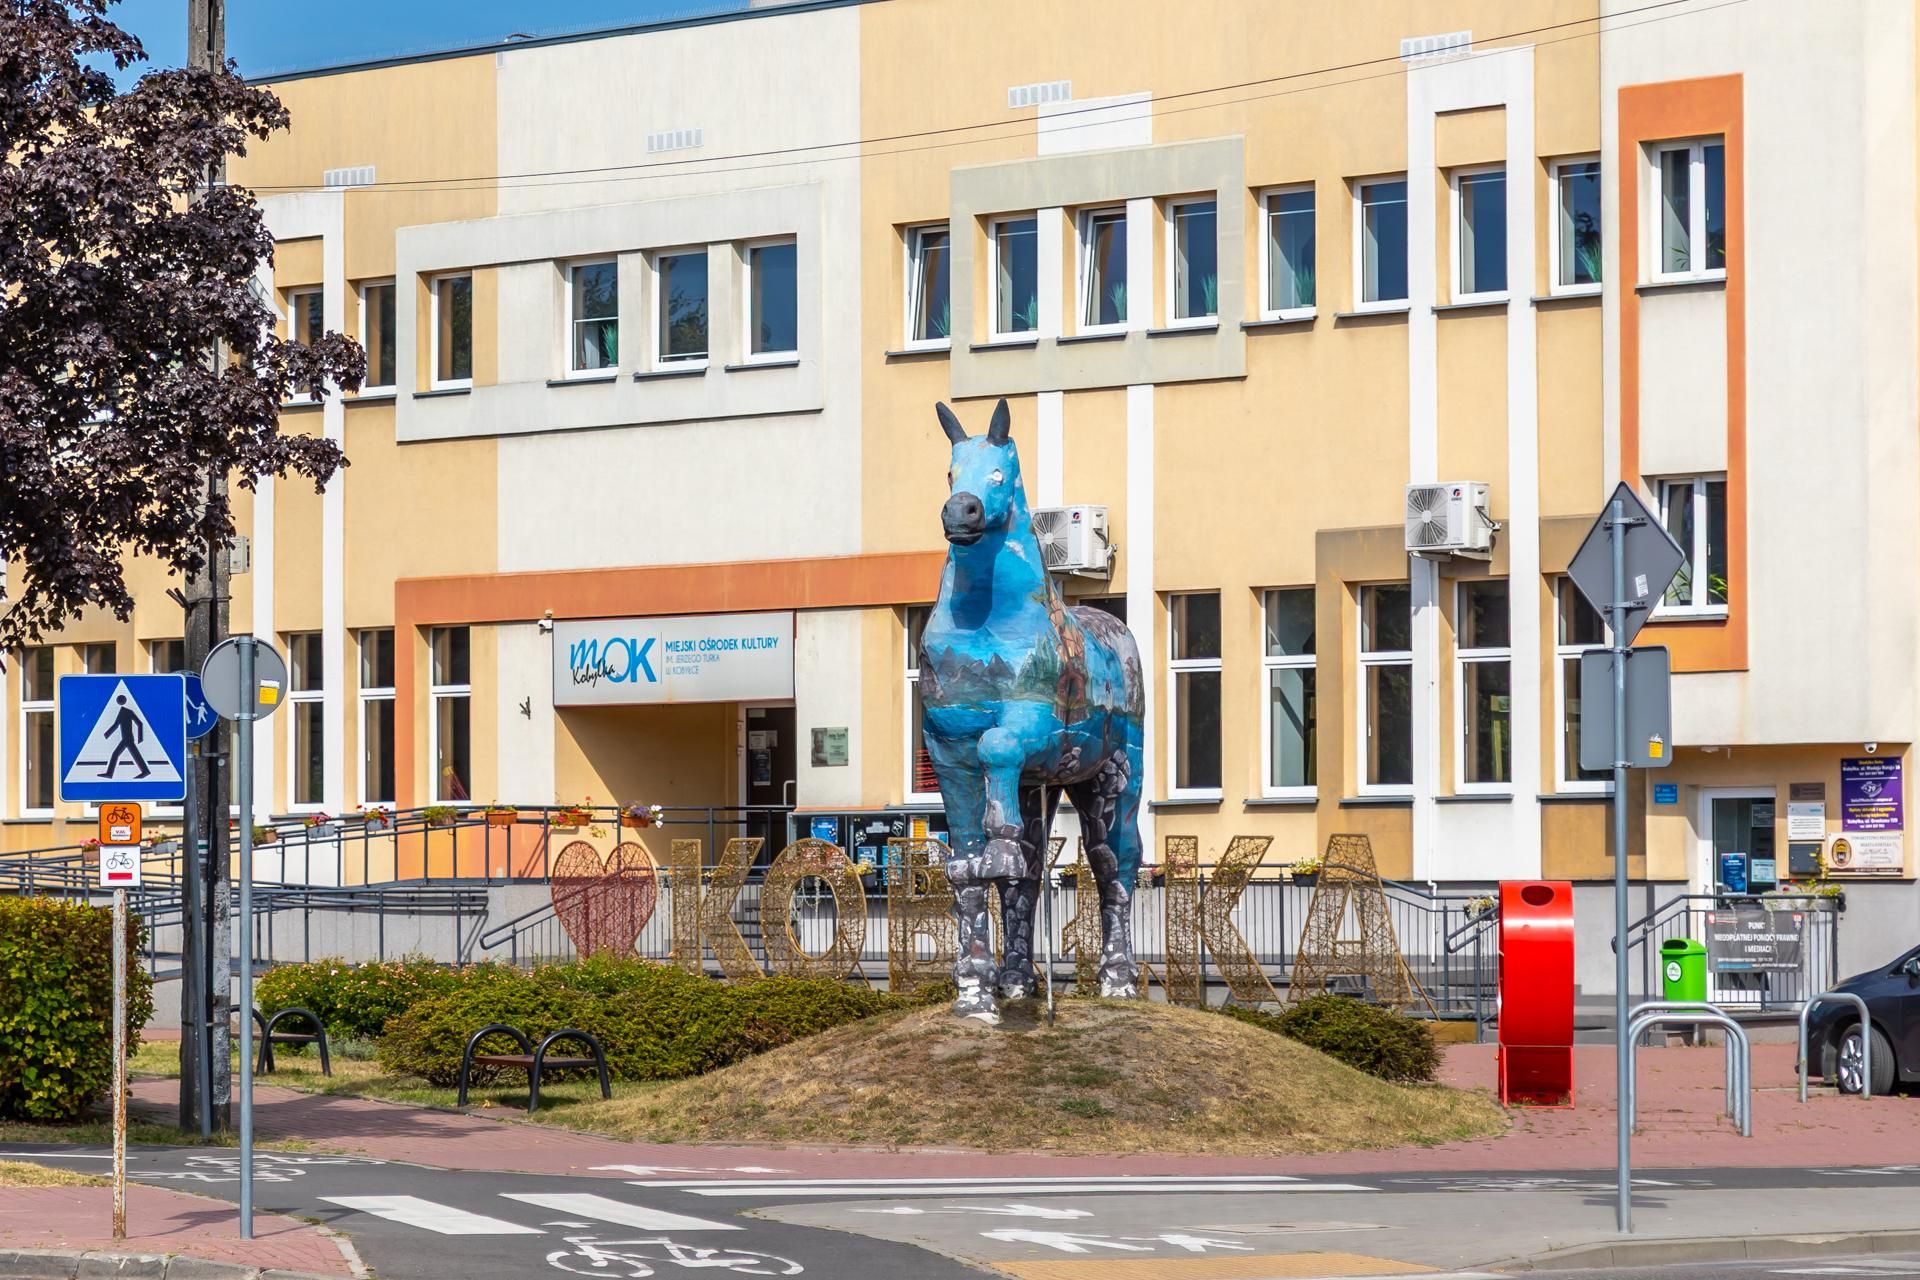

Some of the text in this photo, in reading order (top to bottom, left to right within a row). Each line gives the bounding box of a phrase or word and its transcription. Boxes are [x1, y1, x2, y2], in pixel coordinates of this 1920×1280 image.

[665, 637, 779, 652] MIEJSKI OŚRODEK KULTURY
[676, 654, 701, 663] JERZEGO
[703, 653, 720, 662] TURKA
